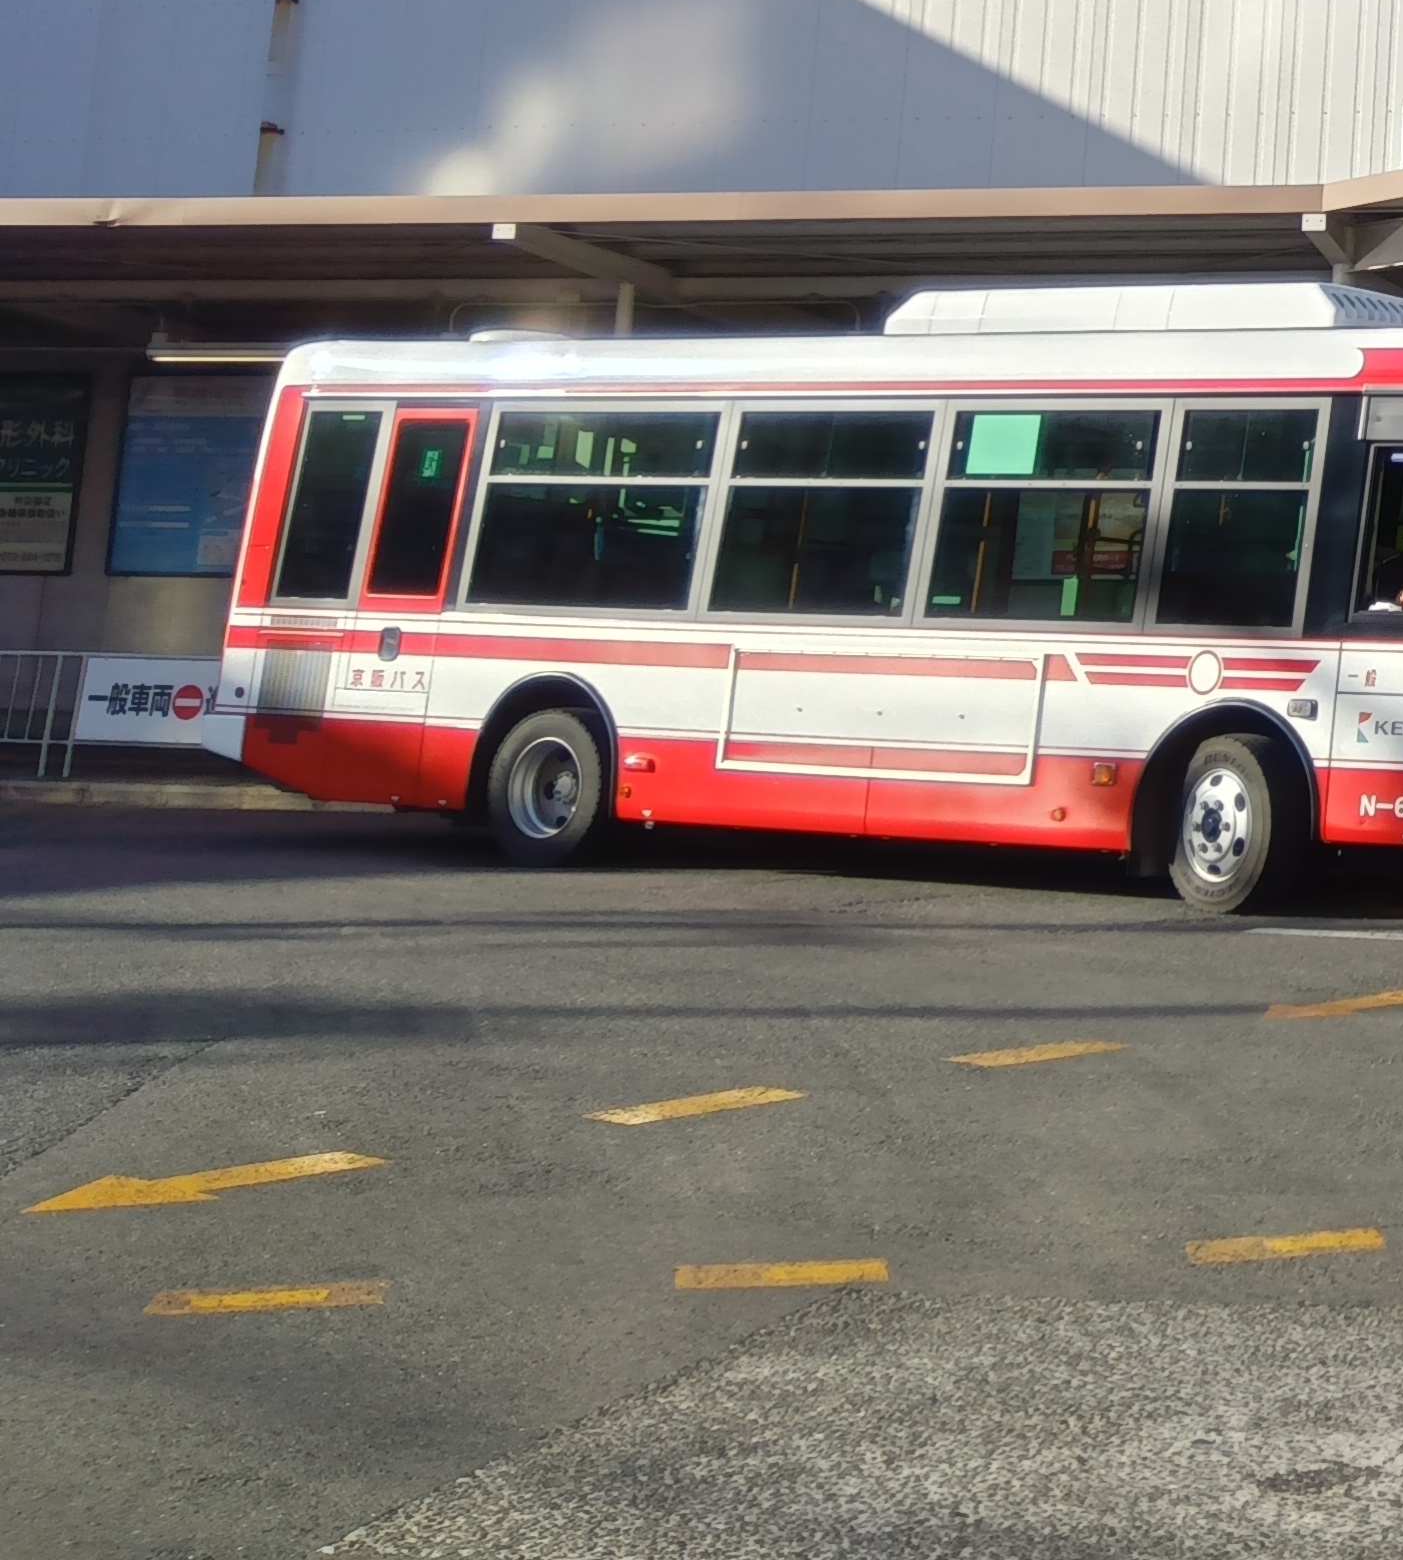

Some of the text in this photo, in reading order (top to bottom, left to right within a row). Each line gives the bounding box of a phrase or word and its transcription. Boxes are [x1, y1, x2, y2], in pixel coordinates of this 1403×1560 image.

[349, 668, 426, 691] 京阪バス
[87, 681, 175, 718] 一般車両
